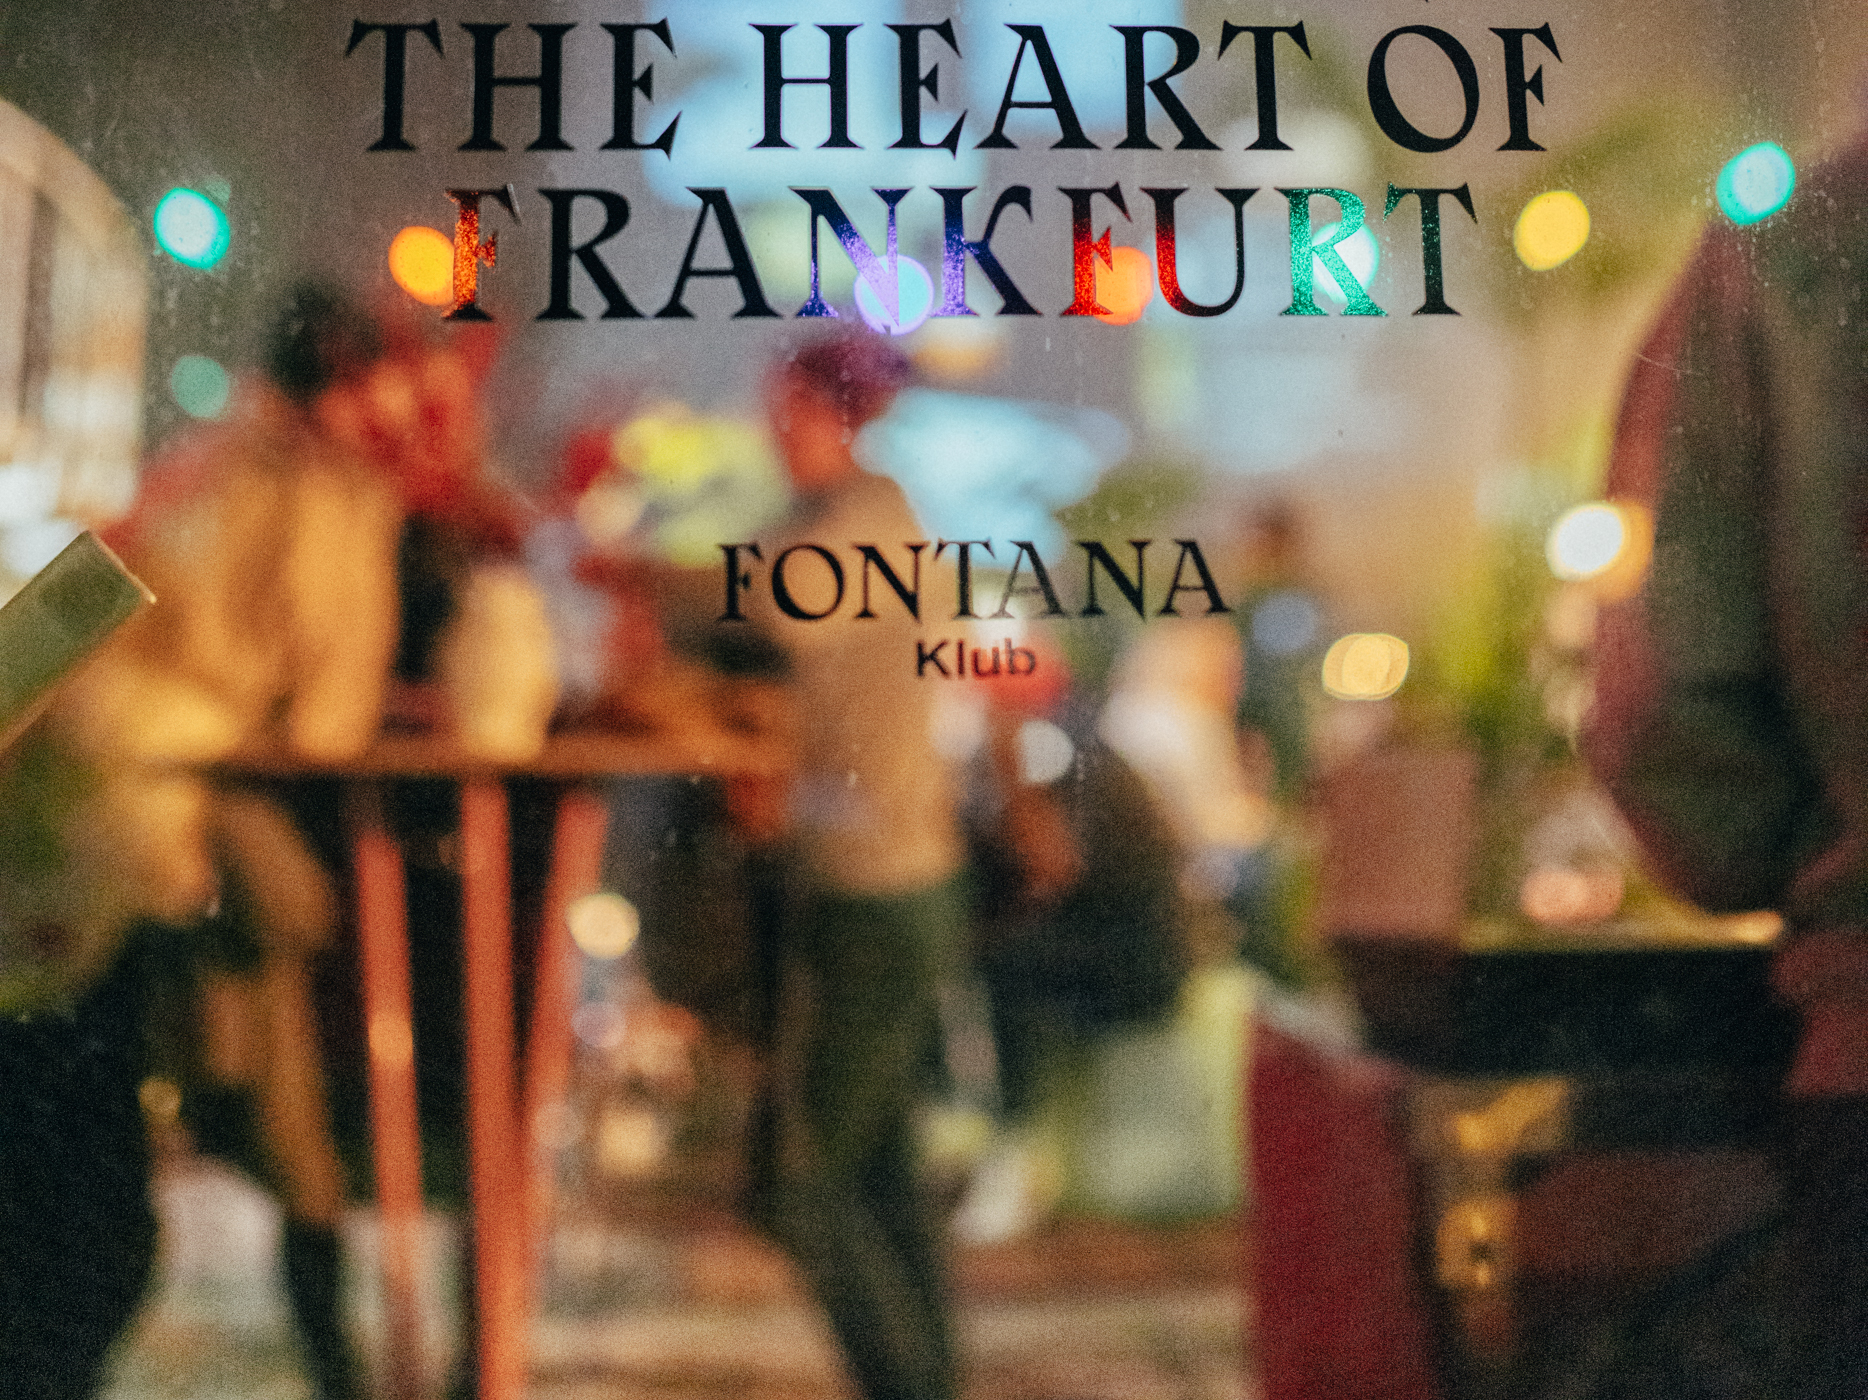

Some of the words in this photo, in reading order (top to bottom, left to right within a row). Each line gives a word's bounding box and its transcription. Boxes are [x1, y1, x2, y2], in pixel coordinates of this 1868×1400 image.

[345, 18, 682, 161] THE
[748, 18, 1312, 161] HEART
[1367, 21, 1563, 153] OF
[442, 181, 1478, 335] FRANKFURT
[716, 537, 1234, 623] FONTANA
[915, 637, 1038, 680] Klub
